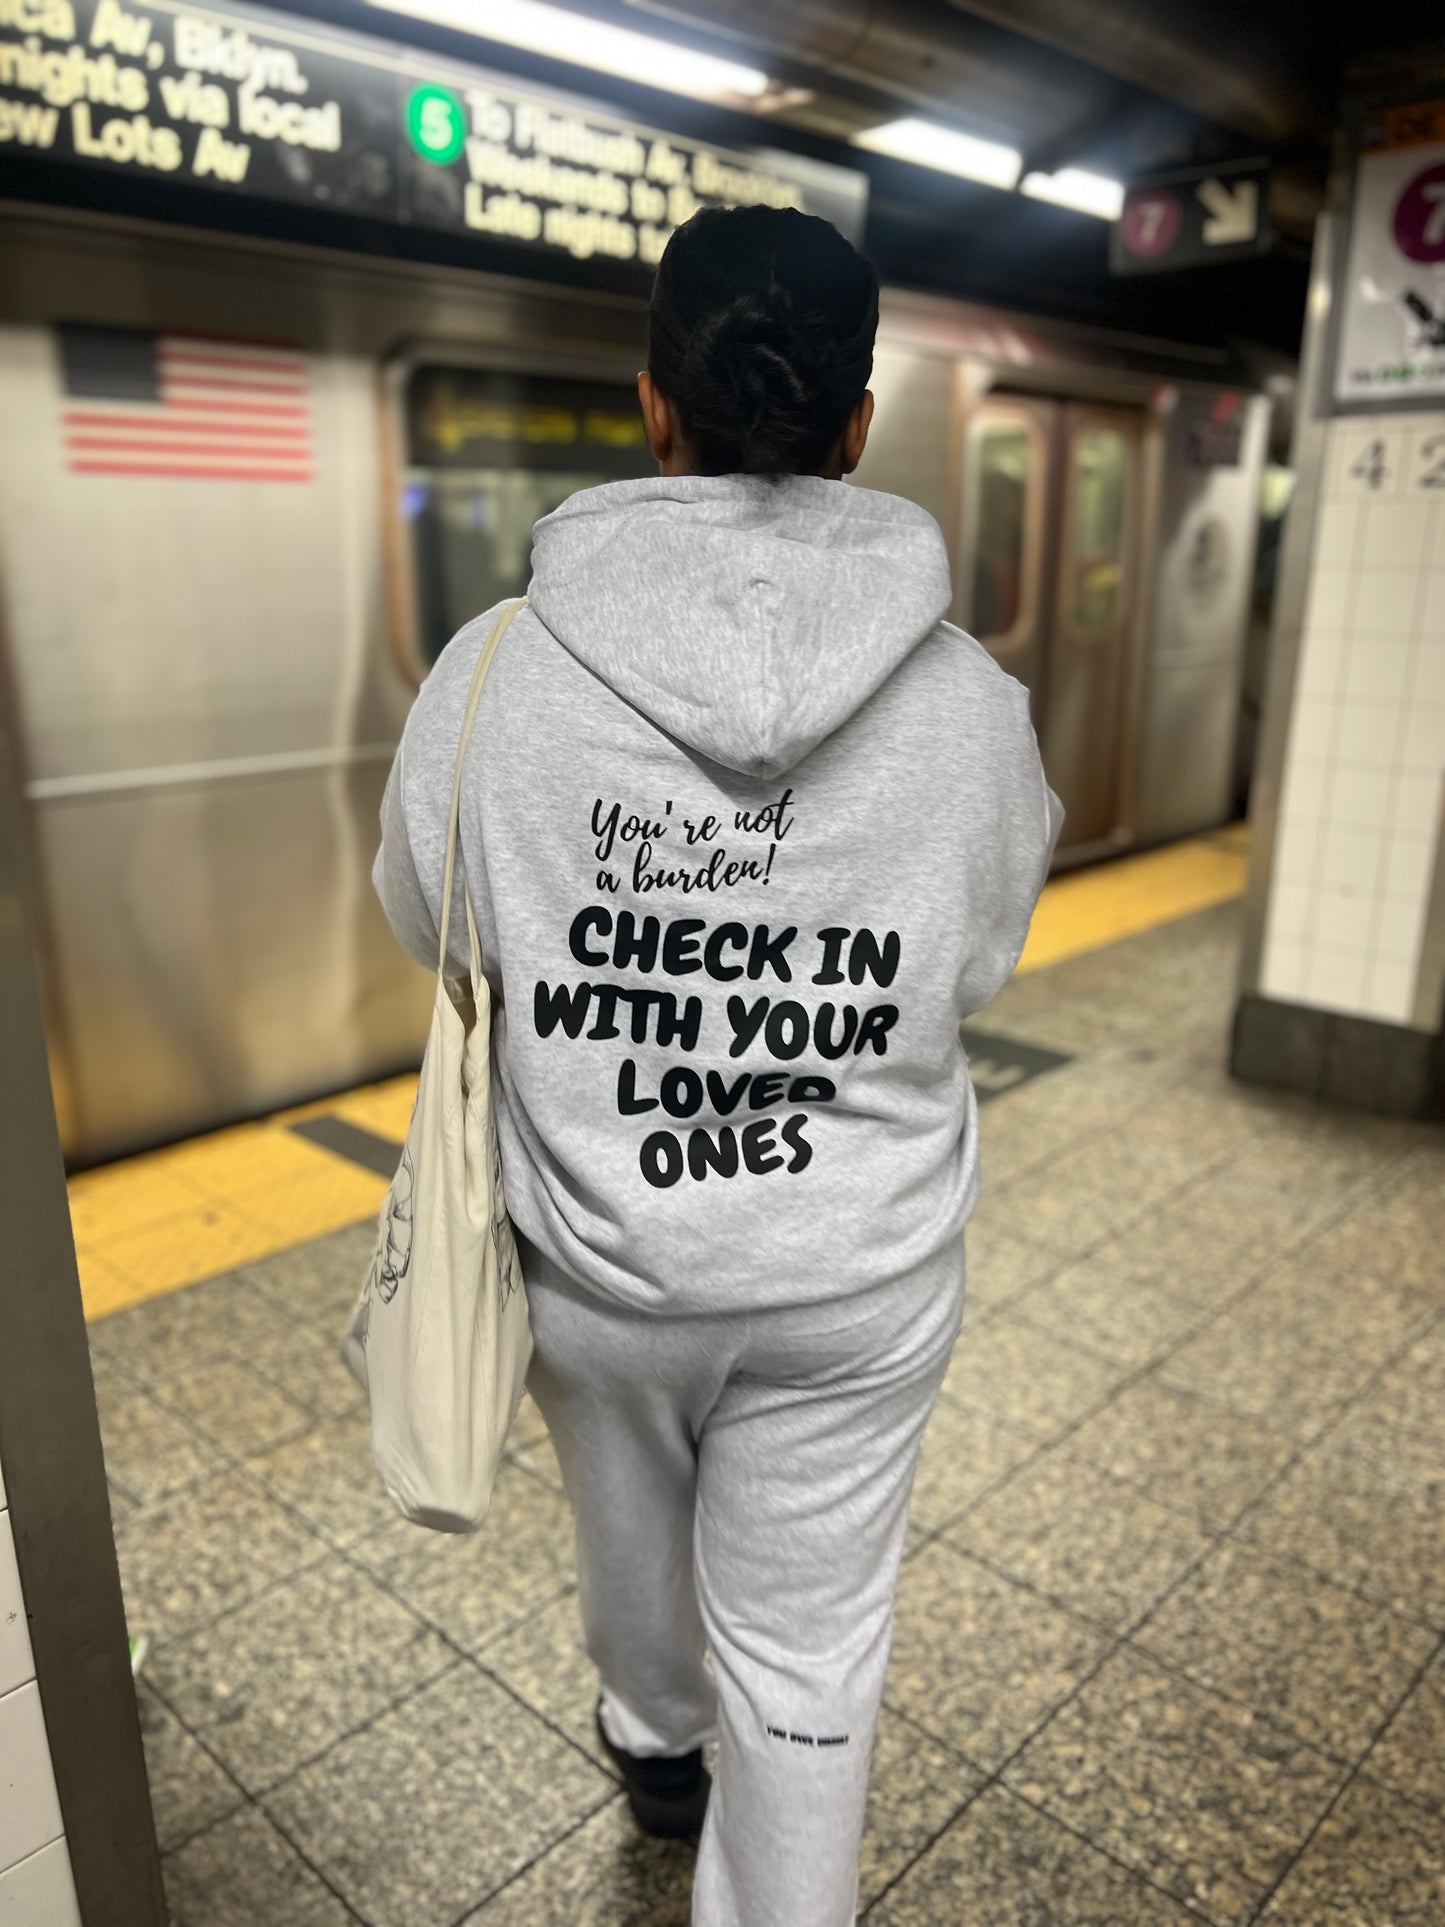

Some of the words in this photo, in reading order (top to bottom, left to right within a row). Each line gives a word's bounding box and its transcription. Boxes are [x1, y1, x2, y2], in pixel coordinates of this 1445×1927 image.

[71, 101, 182, 172] Lots
[192, 127, 251, 183] Av
[159, 70, 230, 129] via
[238, 84, 342, 152] local
[420, 95, 453, 151] 5
[1134, 202, 1165, 245] 7
[592, 798, 721, 861] You're
[735, 788, 794, 841] not
[596, 870, 620, 893] a
[633, 842, 776, 894] burden!
[569, 905, 798, 983] CHECK
[812, 928, 900, 988] IN
[534, 980, 702, 1051] WITH
[727, 995, 899, 1061] YOUR
[617, 1058, 837, 1118] LOVED
[640, 1113, 813, 1189] ONES
